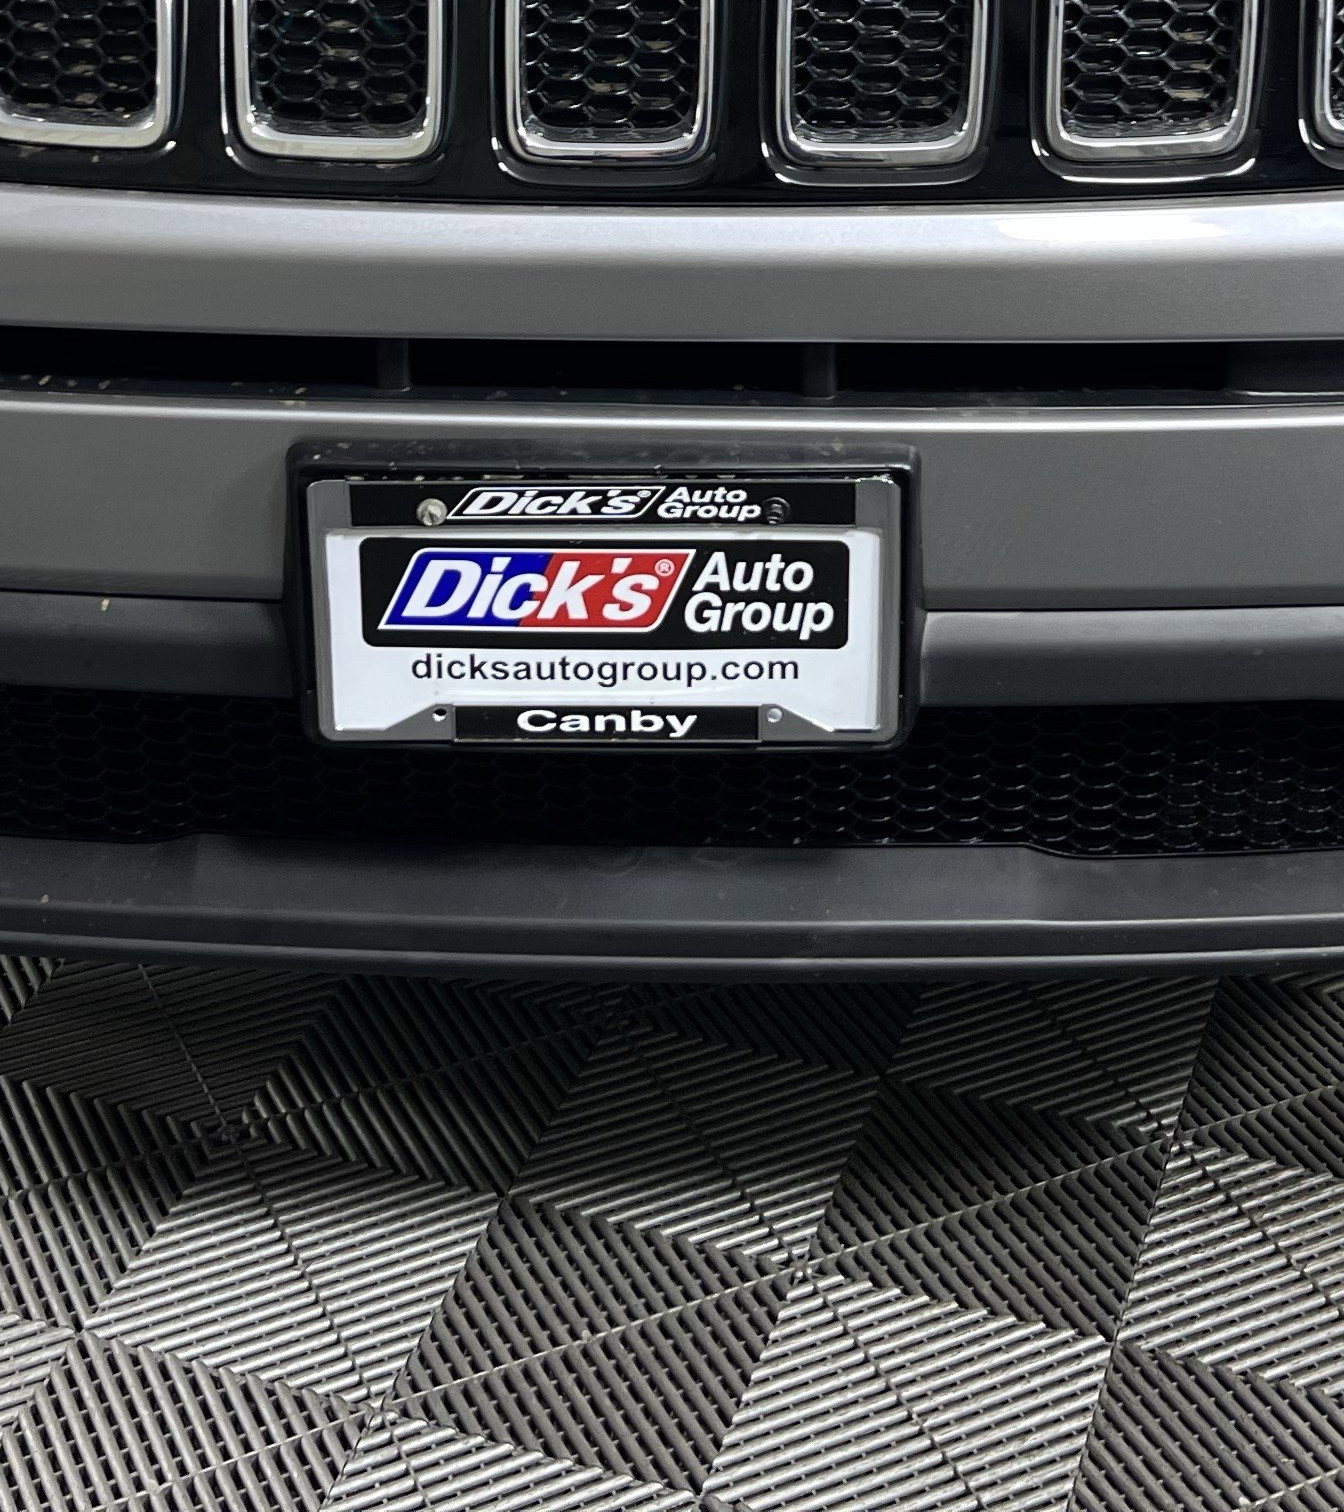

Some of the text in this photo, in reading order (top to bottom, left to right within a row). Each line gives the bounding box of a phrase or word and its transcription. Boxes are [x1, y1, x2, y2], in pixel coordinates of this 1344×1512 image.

[462, 487, 748, 515] Dick's Auto
[657, 501, 762, 522] Group
[401, 552, 815, 622] Dick's Auto
[683, 593, 835, 640] Group
[411, 654, 800, 688] dicksautogroup.com
[516, 709, 698, 738] Canby
